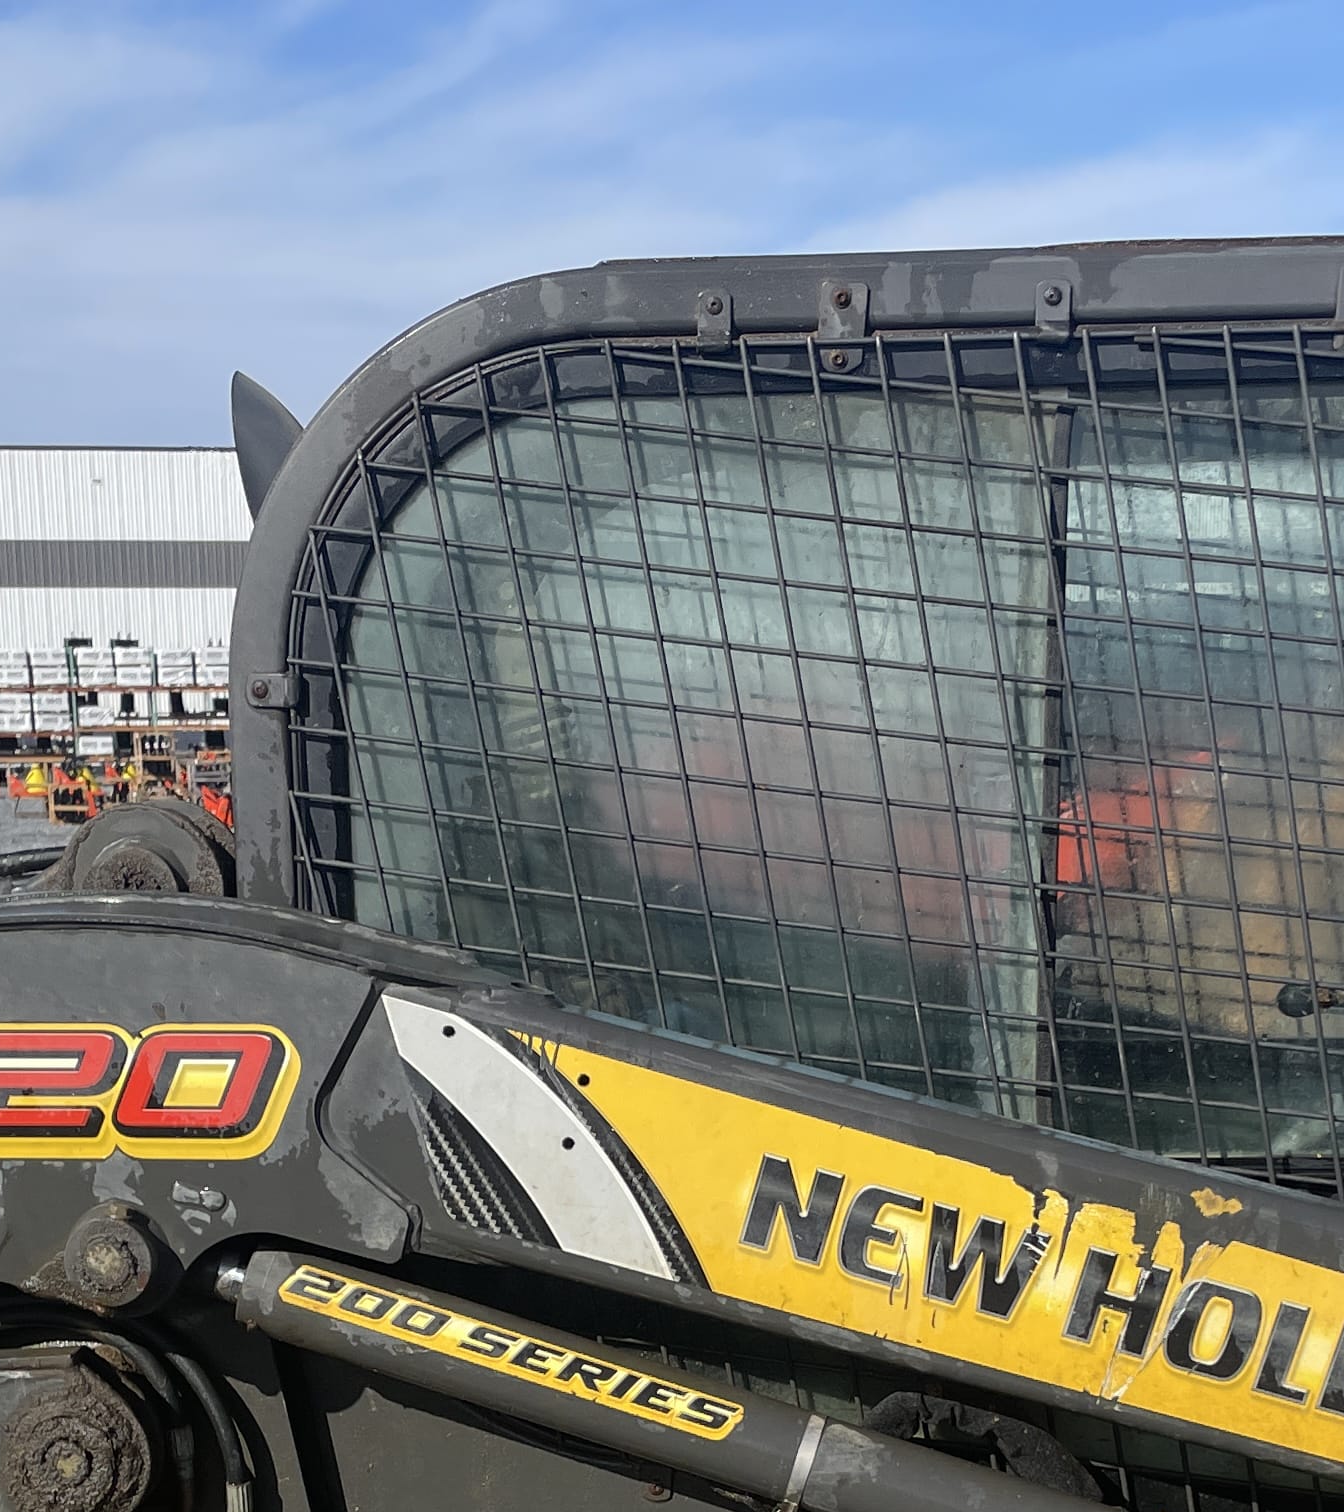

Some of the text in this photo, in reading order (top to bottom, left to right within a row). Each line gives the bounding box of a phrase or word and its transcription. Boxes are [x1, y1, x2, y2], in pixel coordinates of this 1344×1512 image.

[739, 1152, 1052, 1321] NEW
[283, 1268, 743, 1431] 200 SERIES
